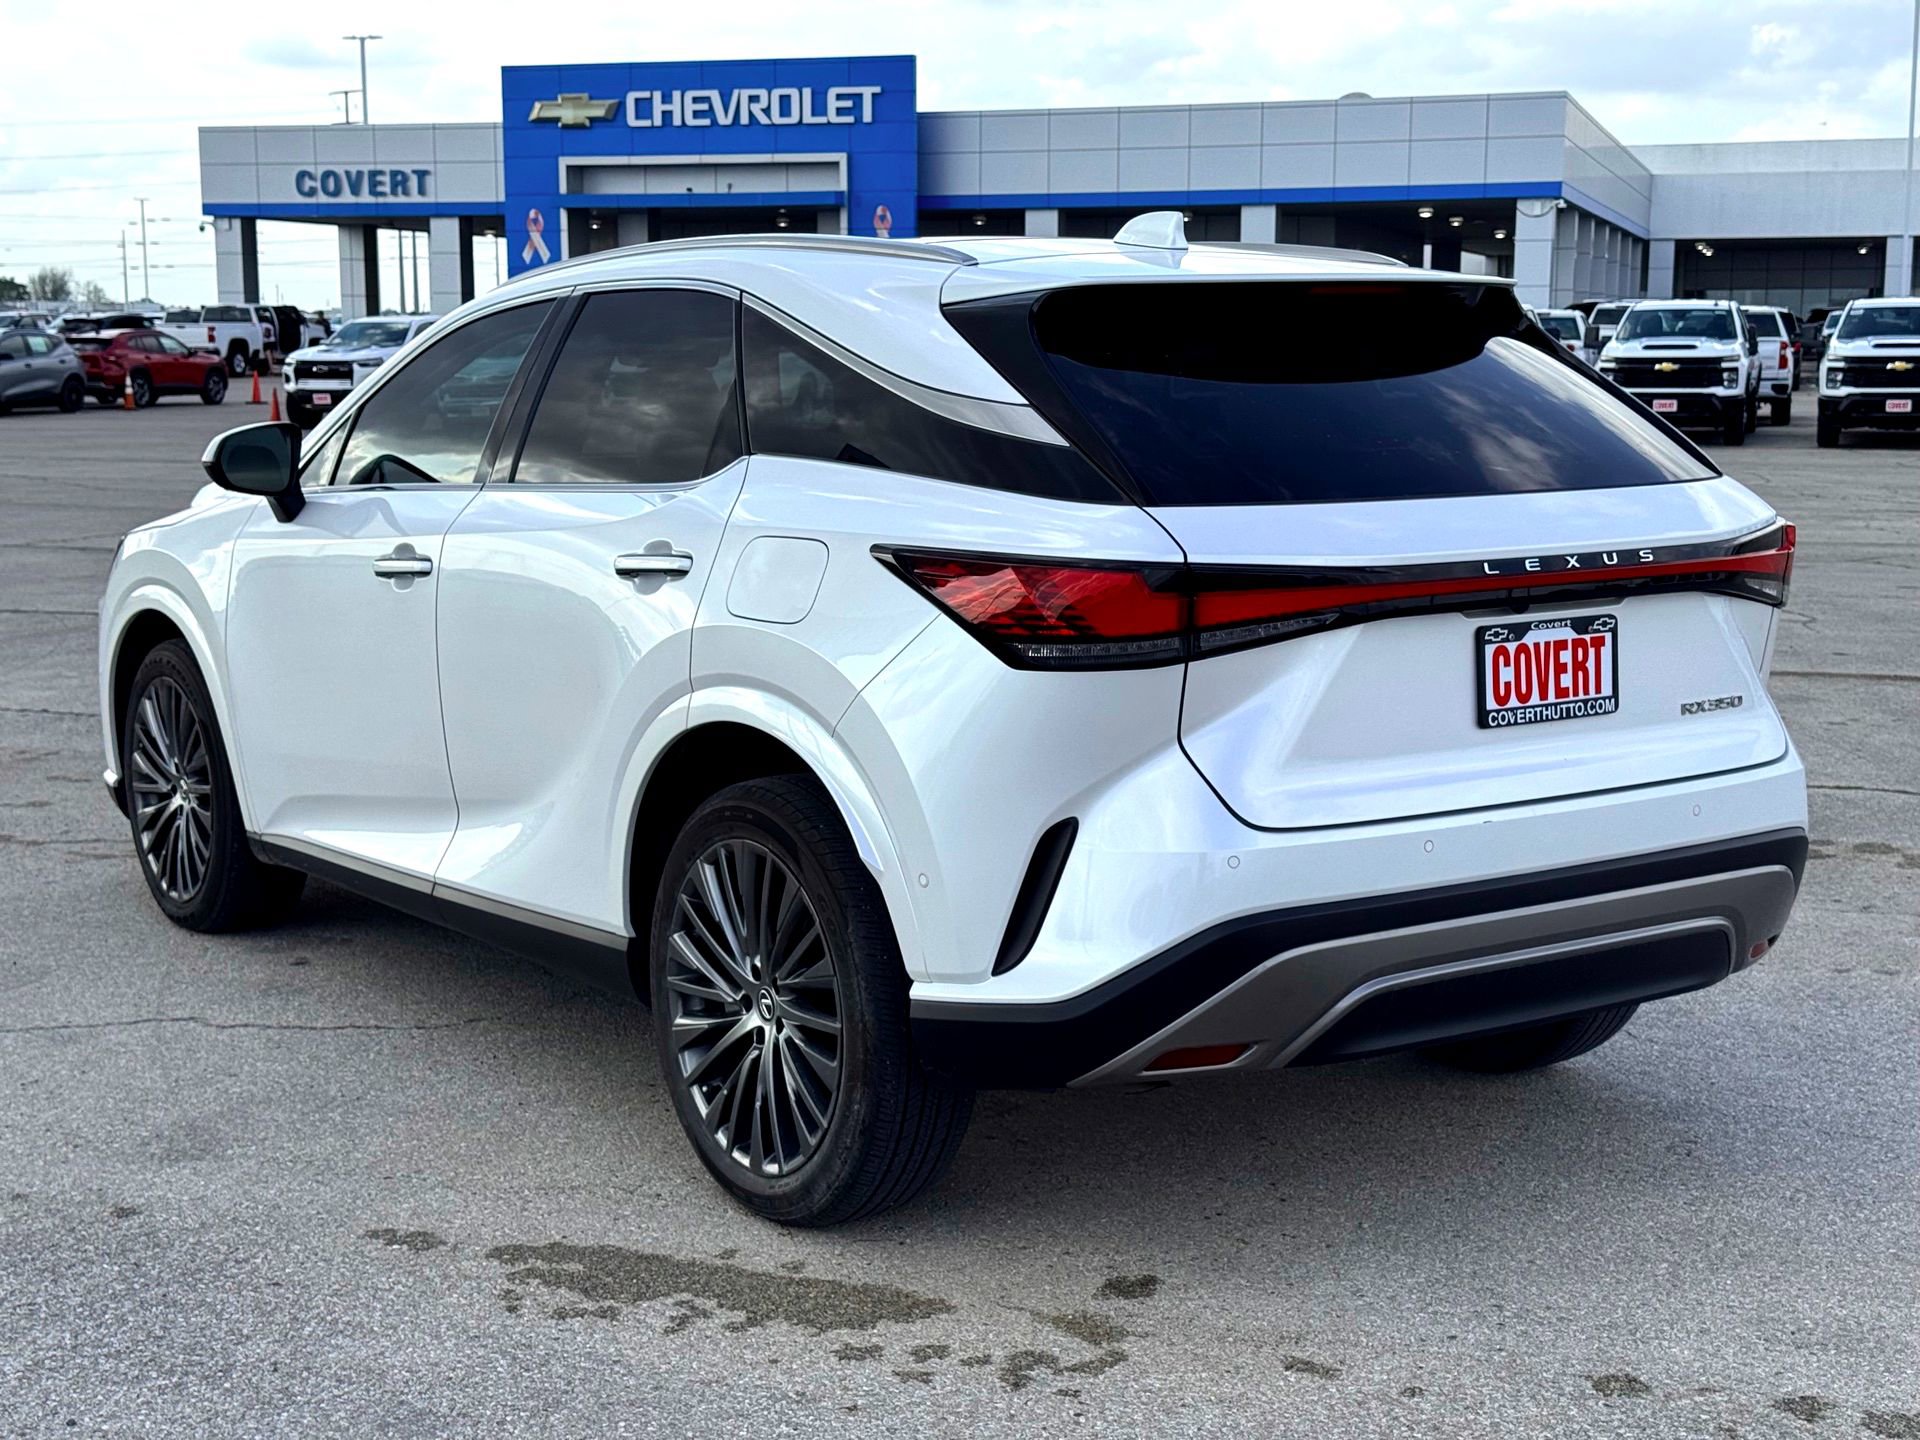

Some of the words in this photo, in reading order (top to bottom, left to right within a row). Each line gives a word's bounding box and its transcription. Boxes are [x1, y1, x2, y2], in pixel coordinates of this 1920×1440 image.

[625, 86, 881, 127] CHEVROLET
[295, 169, 431, 198] COVERT
[1483, 549, 1654, 575] LEXUS
[1530, 620, 1572, 631] Covert
[1492, 635, 1606, 707] COVERT
[1488, 698, 1616, 727] COVERTHUTTO.COM
